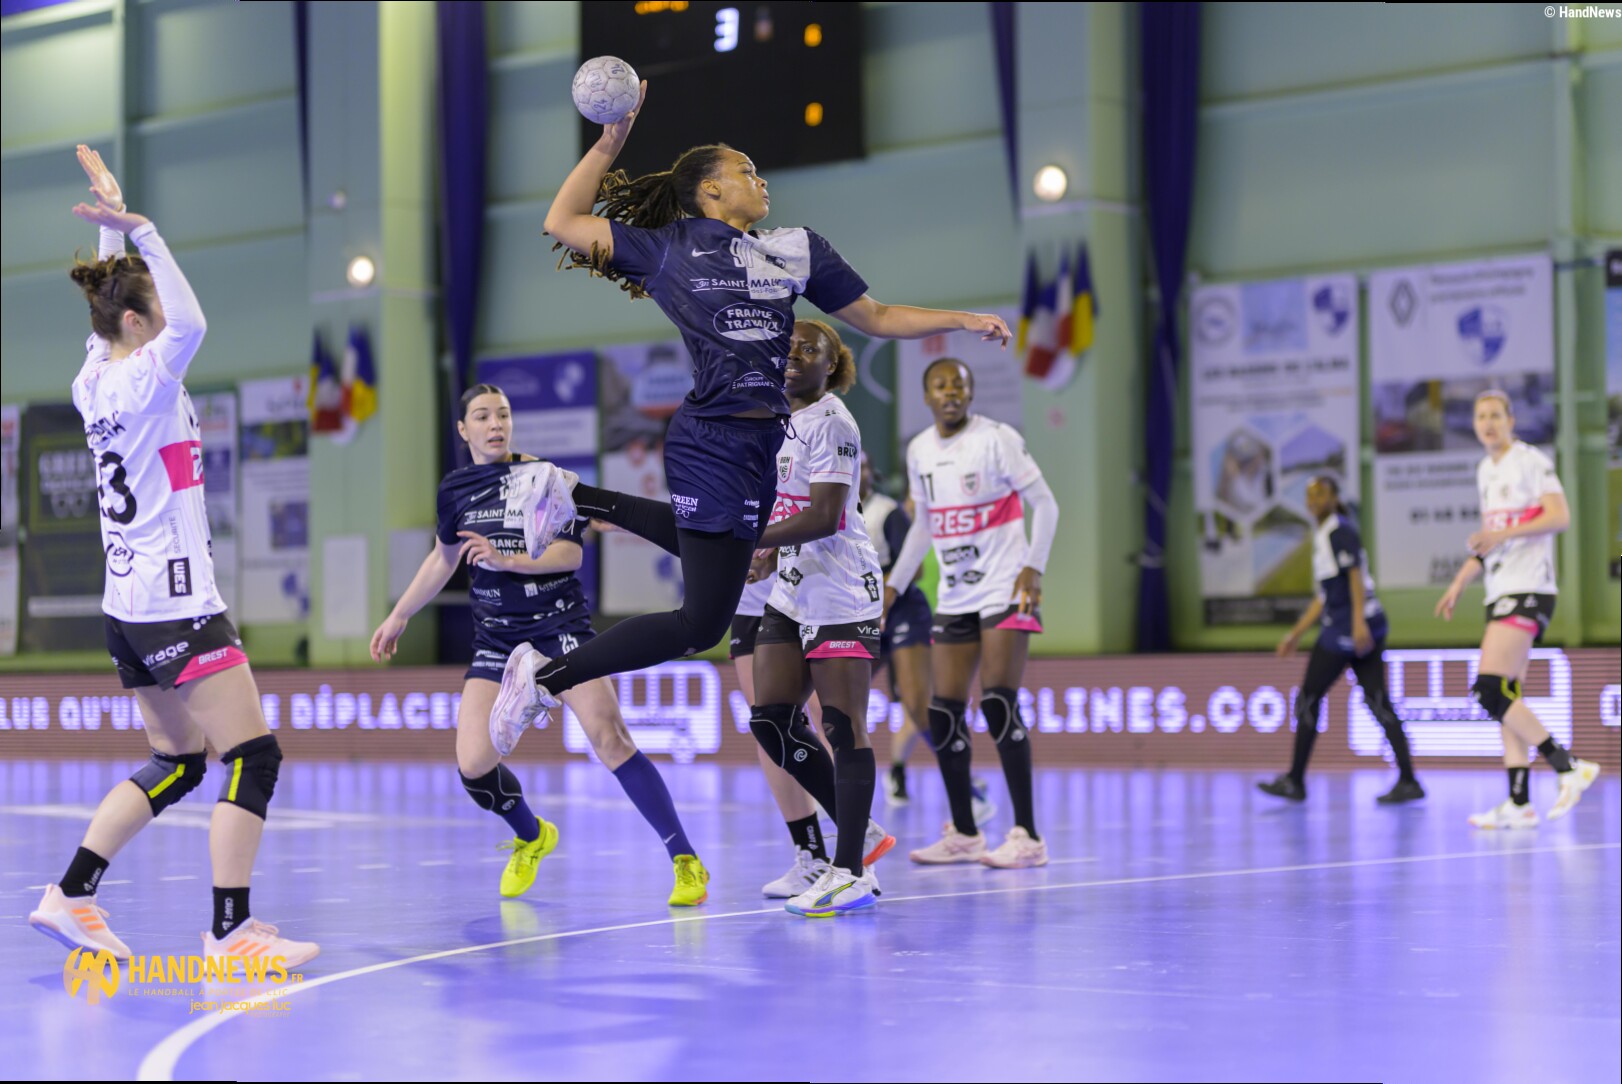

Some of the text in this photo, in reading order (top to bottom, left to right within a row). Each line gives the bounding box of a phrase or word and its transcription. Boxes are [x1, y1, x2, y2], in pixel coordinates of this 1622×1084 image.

[714, 7, 739, 52] 3
[671, 493, 698, 507] GREEN
[931, 504, 996, 536] REST
[490, 538, 526, 549] RANCE
[857, 626, 881, 637] vira
[142, 641, 189, 666] virage
[558, 633, 579, 655] 25
[829, 641, 857, 649] BREST
[199, 648, 228, 665] BREST
[290, 684, 463, 730] DÉPLACE
